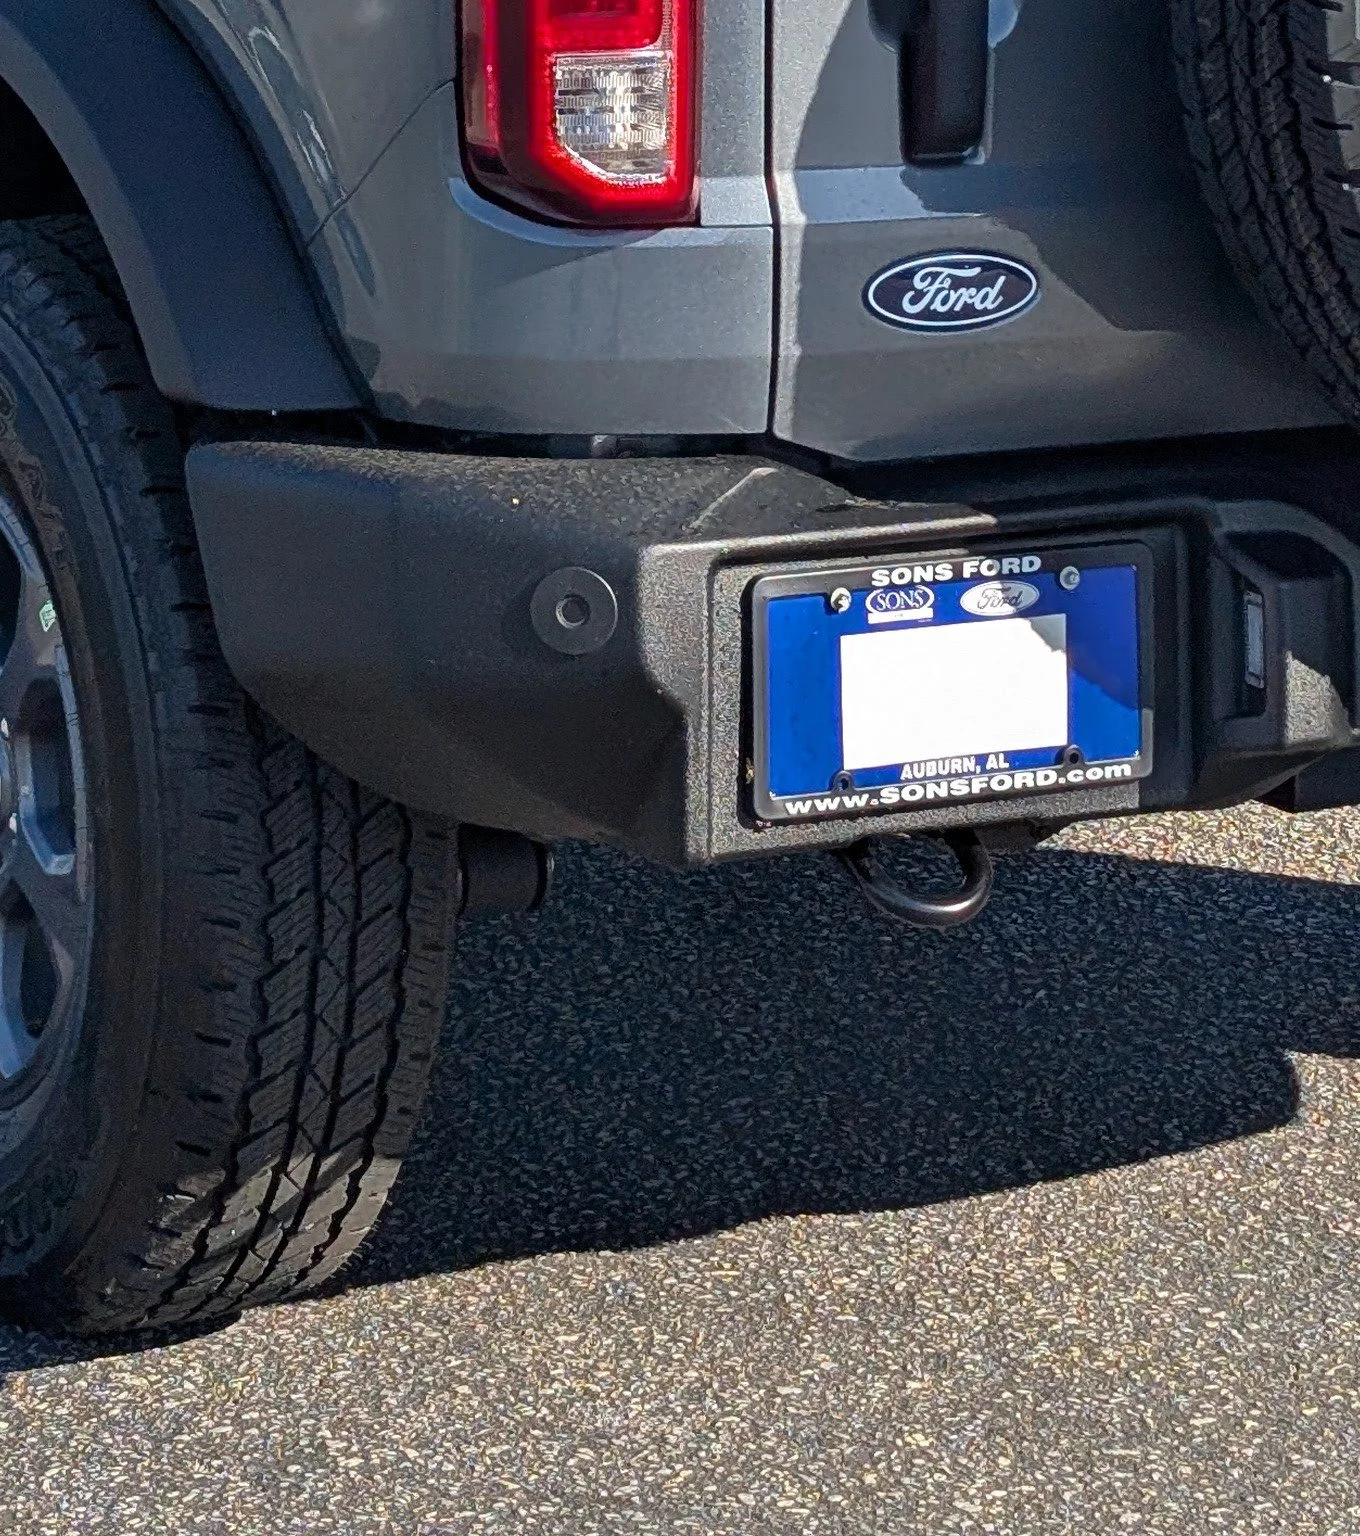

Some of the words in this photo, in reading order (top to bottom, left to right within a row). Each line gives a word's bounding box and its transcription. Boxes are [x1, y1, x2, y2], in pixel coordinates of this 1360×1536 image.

[901, 265, 1008, 314] Ford
[871, 563, 953, 587] SONS
[962, 555, 1042, 579] FORD
[875, 588, 924, 612] SONS
[976, 585, 1024, 610] Ford
[900, 755, 981, 781] AUBURN,
[985, 752, 1010, 770] AL
[784, 762, 1132, 816] www.SONSFORD.com
